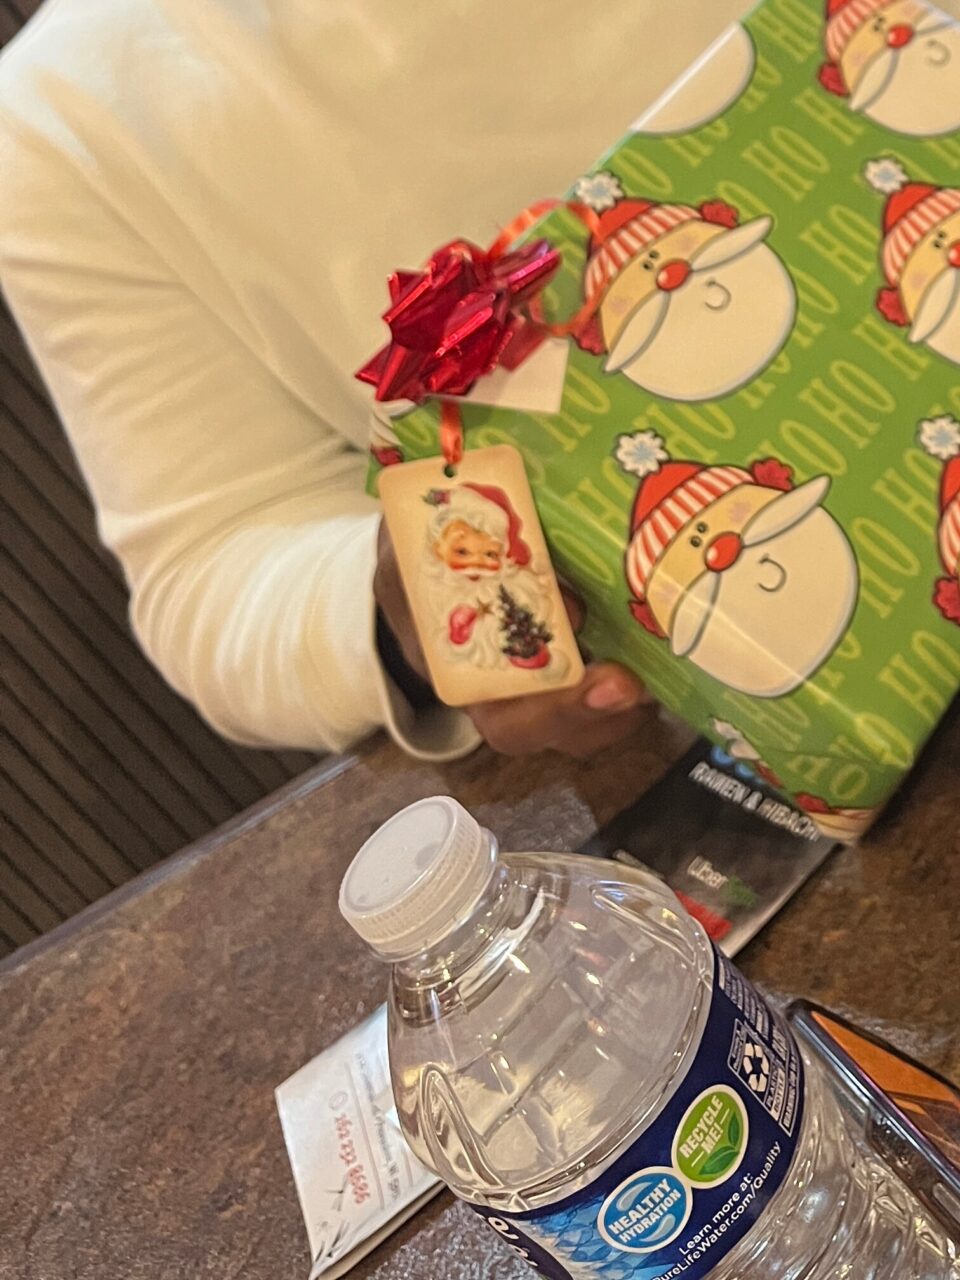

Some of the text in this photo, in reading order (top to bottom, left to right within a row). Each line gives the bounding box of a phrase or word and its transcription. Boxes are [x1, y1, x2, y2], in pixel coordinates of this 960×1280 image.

[739, 126, 829, 204] HO
[797, 205, 889, 287] HO
[796, 360, 896, 450] HO
[741, 791, 763, 811] &
[678, 1094, 724, 1160] RECYCLE
[700, 1122, 725, 1156] ME!
[609, 1177, 672, 1235] HEALTHY
[618, 1187, 682, 1244] HYDRATION
[678, 1172, 754, 1256] Learn more at:
